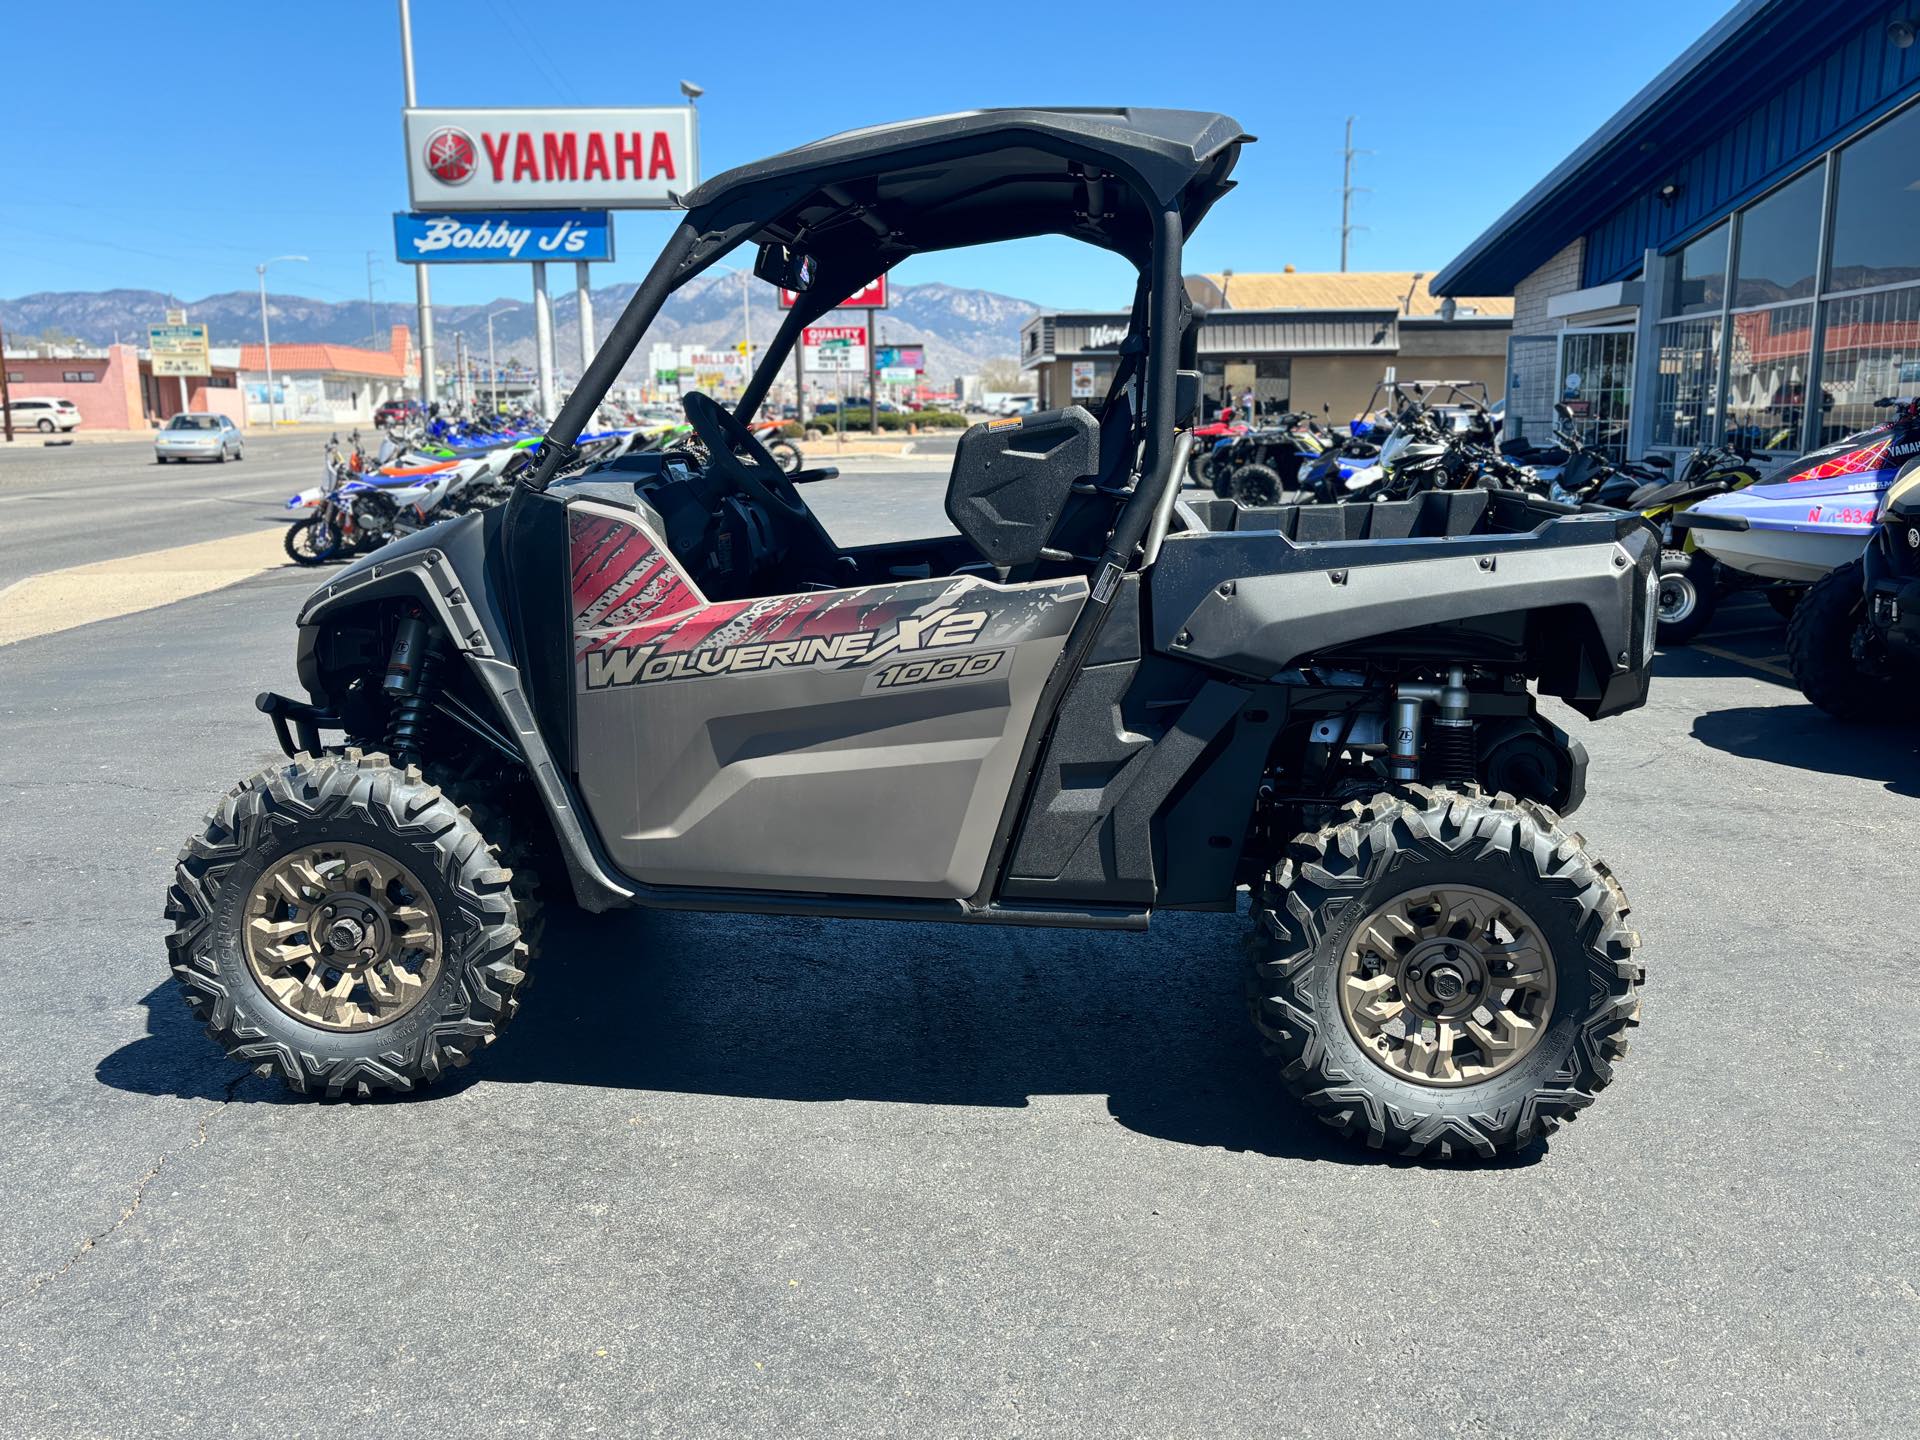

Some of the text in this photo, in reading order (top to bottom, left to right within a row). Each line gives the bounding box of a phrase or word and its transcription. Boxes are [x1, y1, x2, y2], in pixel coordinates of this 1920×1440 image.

[481, 131, 676, 182] YAMAHA
[413, 216, 589, 257] Bobby J's
[807, 328, 861, 340] QUALITY
[858, 608, 991, 663] X2
[876, 650, 1005, 688] 1000
[1398, 729, 1413, 742] ZF
[217, 877, 247, 990] BIGHORN
